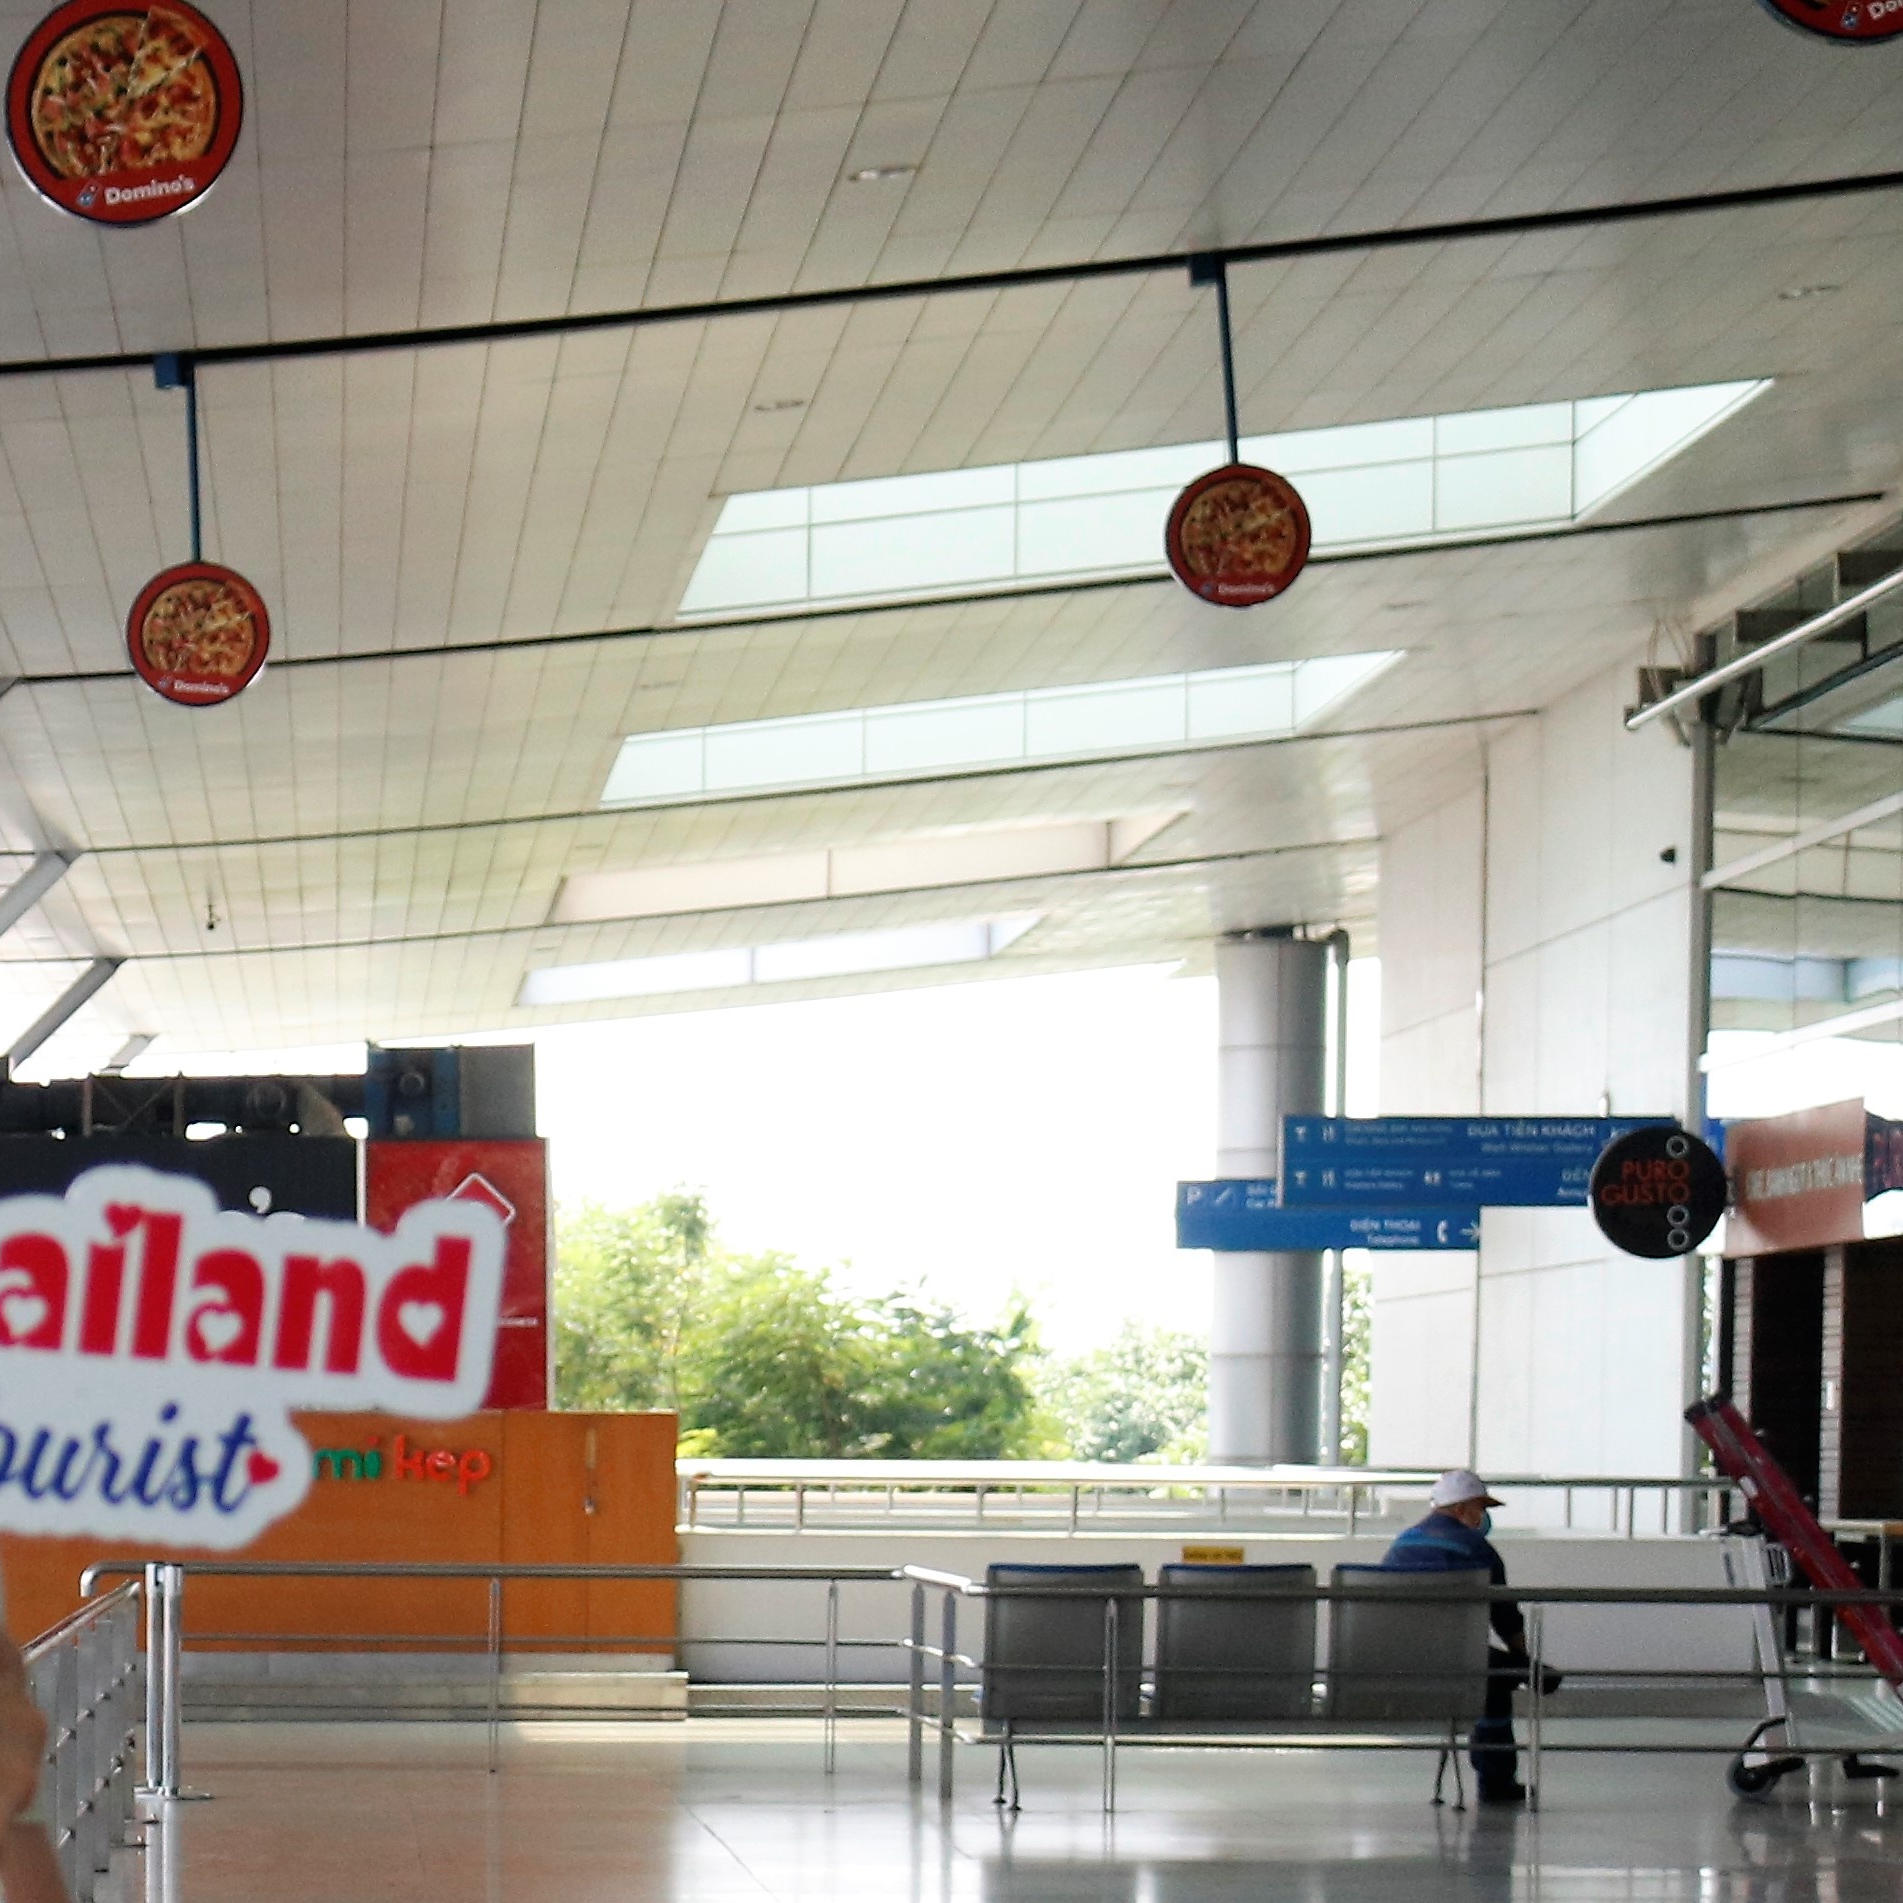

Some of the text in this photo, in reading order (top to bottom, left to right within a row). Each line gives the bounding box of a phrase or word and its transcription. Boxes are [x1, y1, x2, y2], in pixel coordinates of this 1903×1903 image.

[104, 174, 195, 205] Domino's
[1621, 1159, 1690, 1181] PURO
[1600, 1183, 1690, 1204] GUSTO
